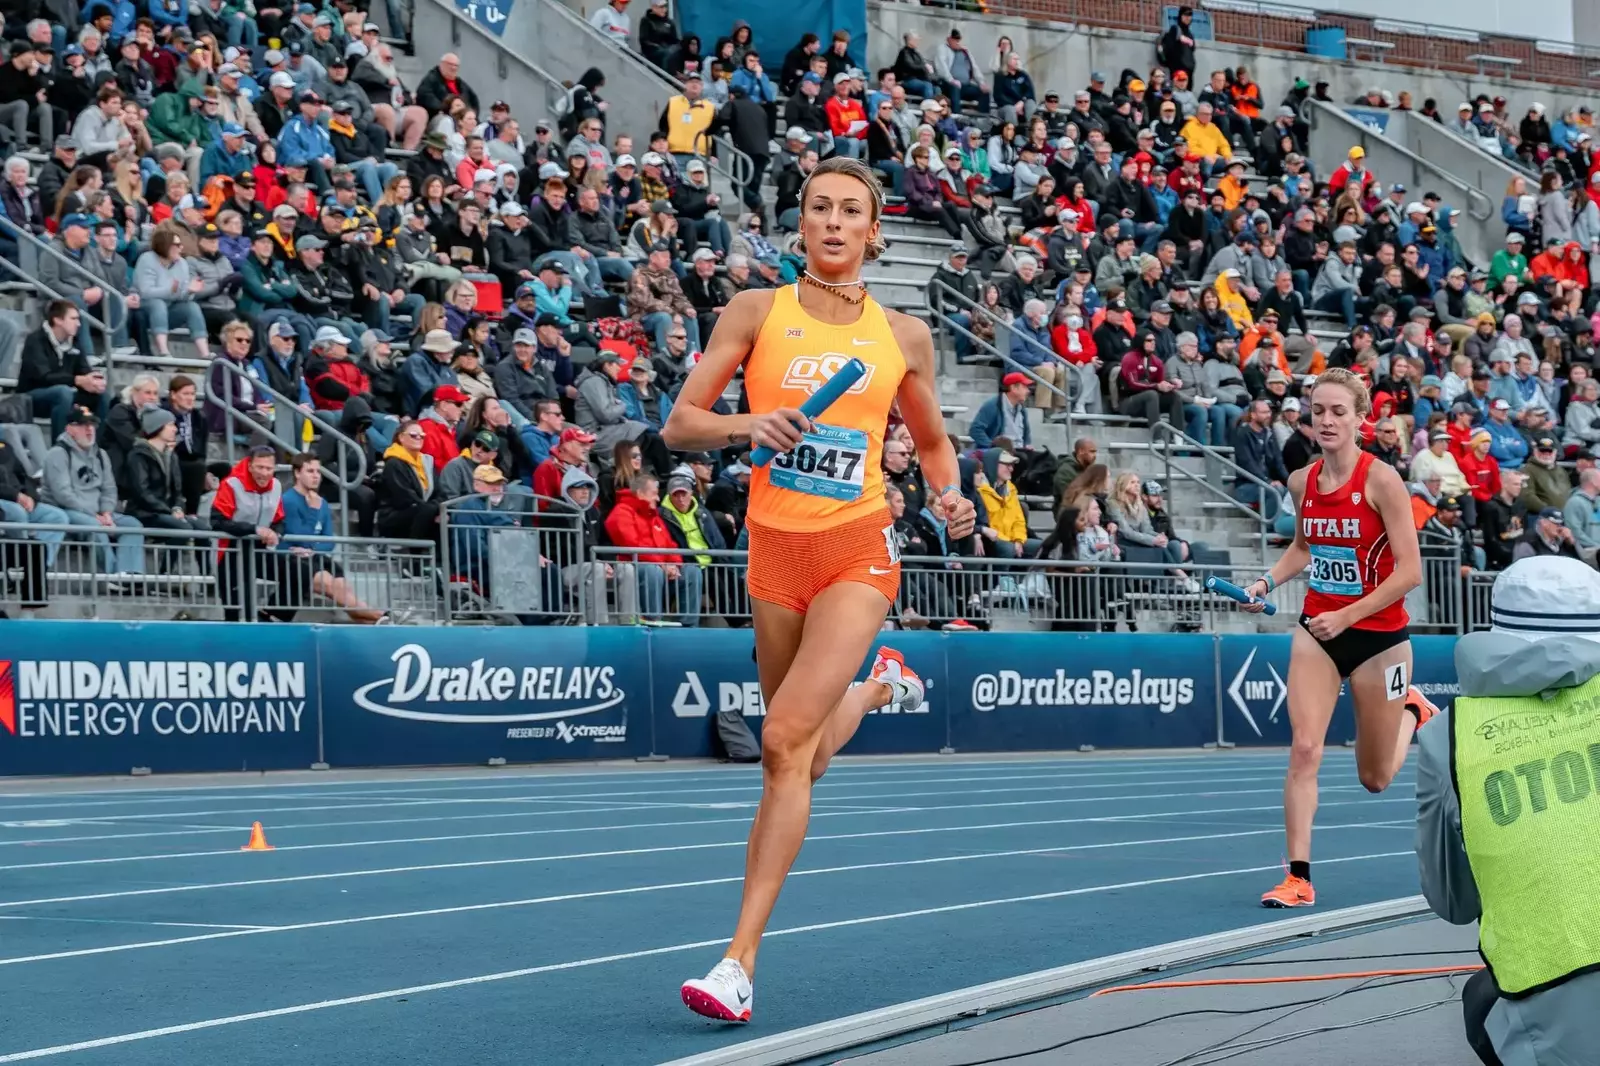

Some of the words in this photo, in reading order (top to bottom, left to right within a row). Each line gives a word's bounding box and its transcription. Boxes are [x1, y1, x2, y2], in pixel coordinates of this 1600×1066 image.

[486, 6, 499, 23] U
[775, 444, 861, 481] 3047
[1303, 517, 1361, 538] UTAH
[1313, 557, 1357, 583] 3305
[18, 660, 306, 699] MIDAMERICAN
[387, 643, 516, 702] Drake
[519, 666, 615, 700] RELAYS
[1390, 665, 1404, 695] 4
[971, 668, 1195, 713] @DrakeRelays
[1244, 680, 1275, 700] IMT
[19, 702, 145, 736] ENERGY
[151, 701, 306, 734] COMPANY
[507, 727, 544, 738] PRESENTED
[545, 727, 555, 738] BY
